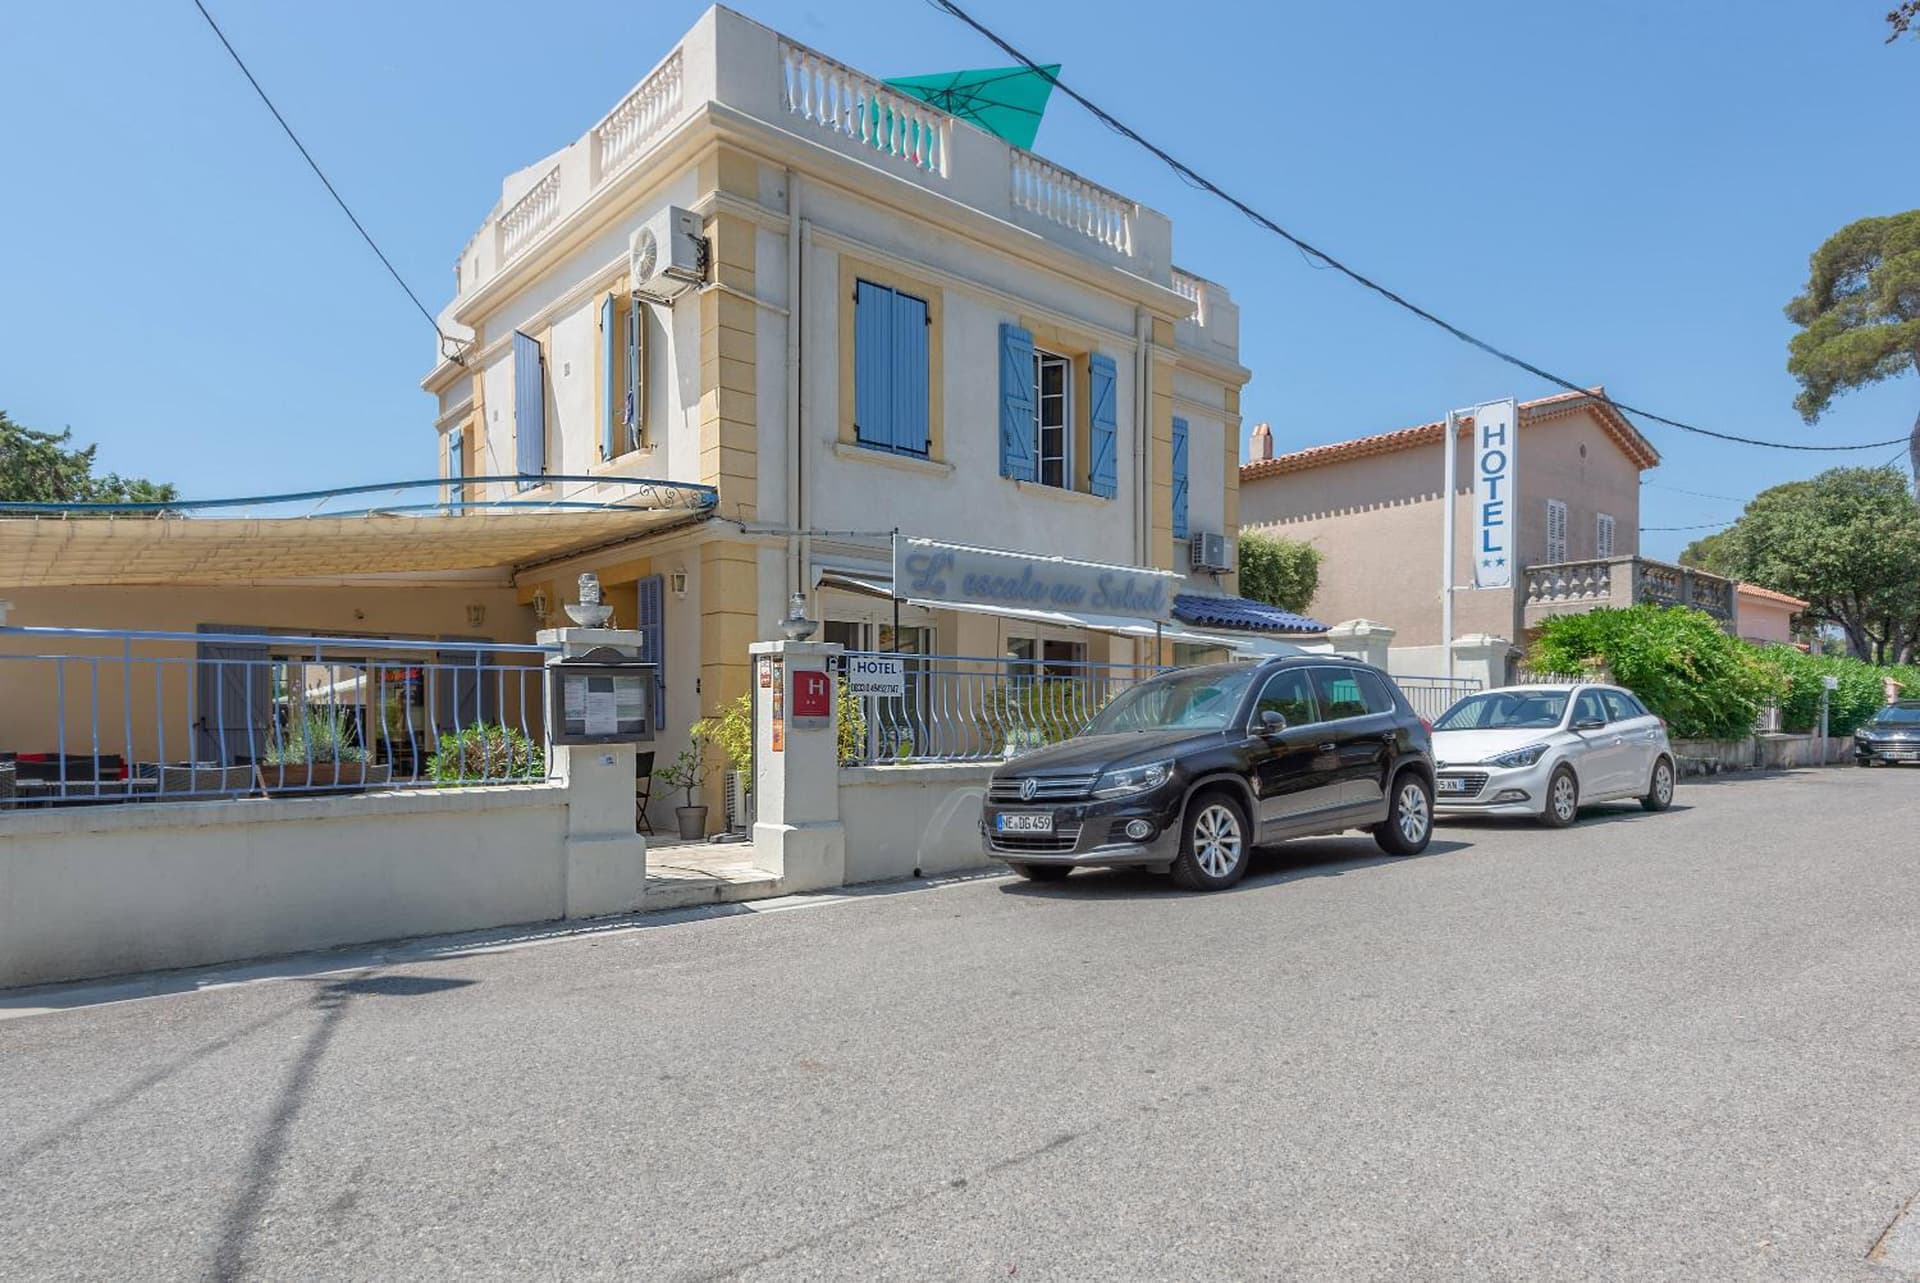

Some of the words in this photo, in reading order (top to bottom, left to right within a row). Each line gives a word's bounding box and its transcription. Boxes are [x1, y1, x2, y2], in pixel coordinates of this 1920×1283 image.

[1481, 424, 1507, 552] HOTEL
[857, 662, 897, 674] HOTEL
[808, 679, 824, 695] H
